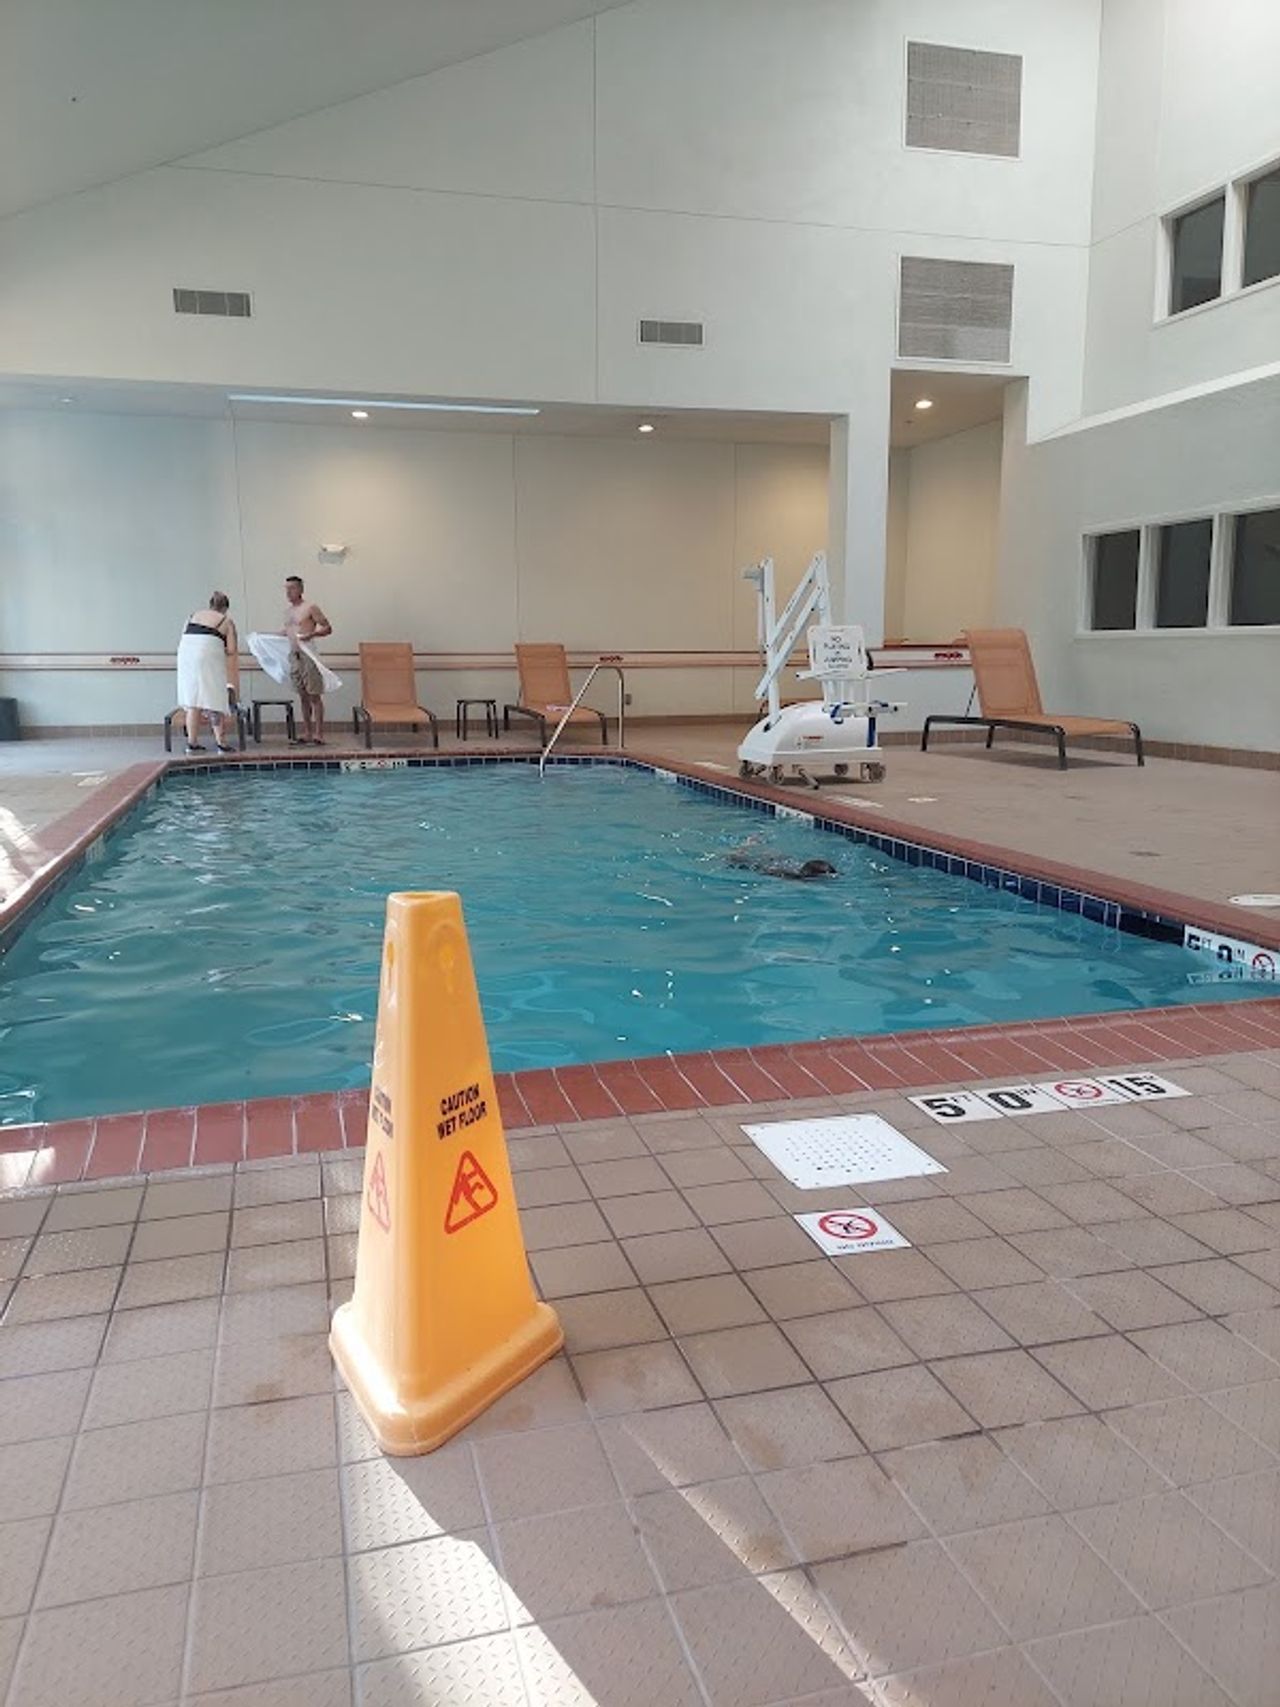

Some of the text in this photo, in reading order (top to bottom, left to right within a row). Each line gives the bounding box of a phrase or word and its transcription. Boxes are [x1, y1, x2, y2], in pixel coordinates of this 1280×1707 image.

[440, 1083, 480, 1116] CAUTION
[920, 1098, 966, 1117] 5
[987, 1091, 1033, 1109] 0
[437, 1101, 487, 1140] WET FLOOR
